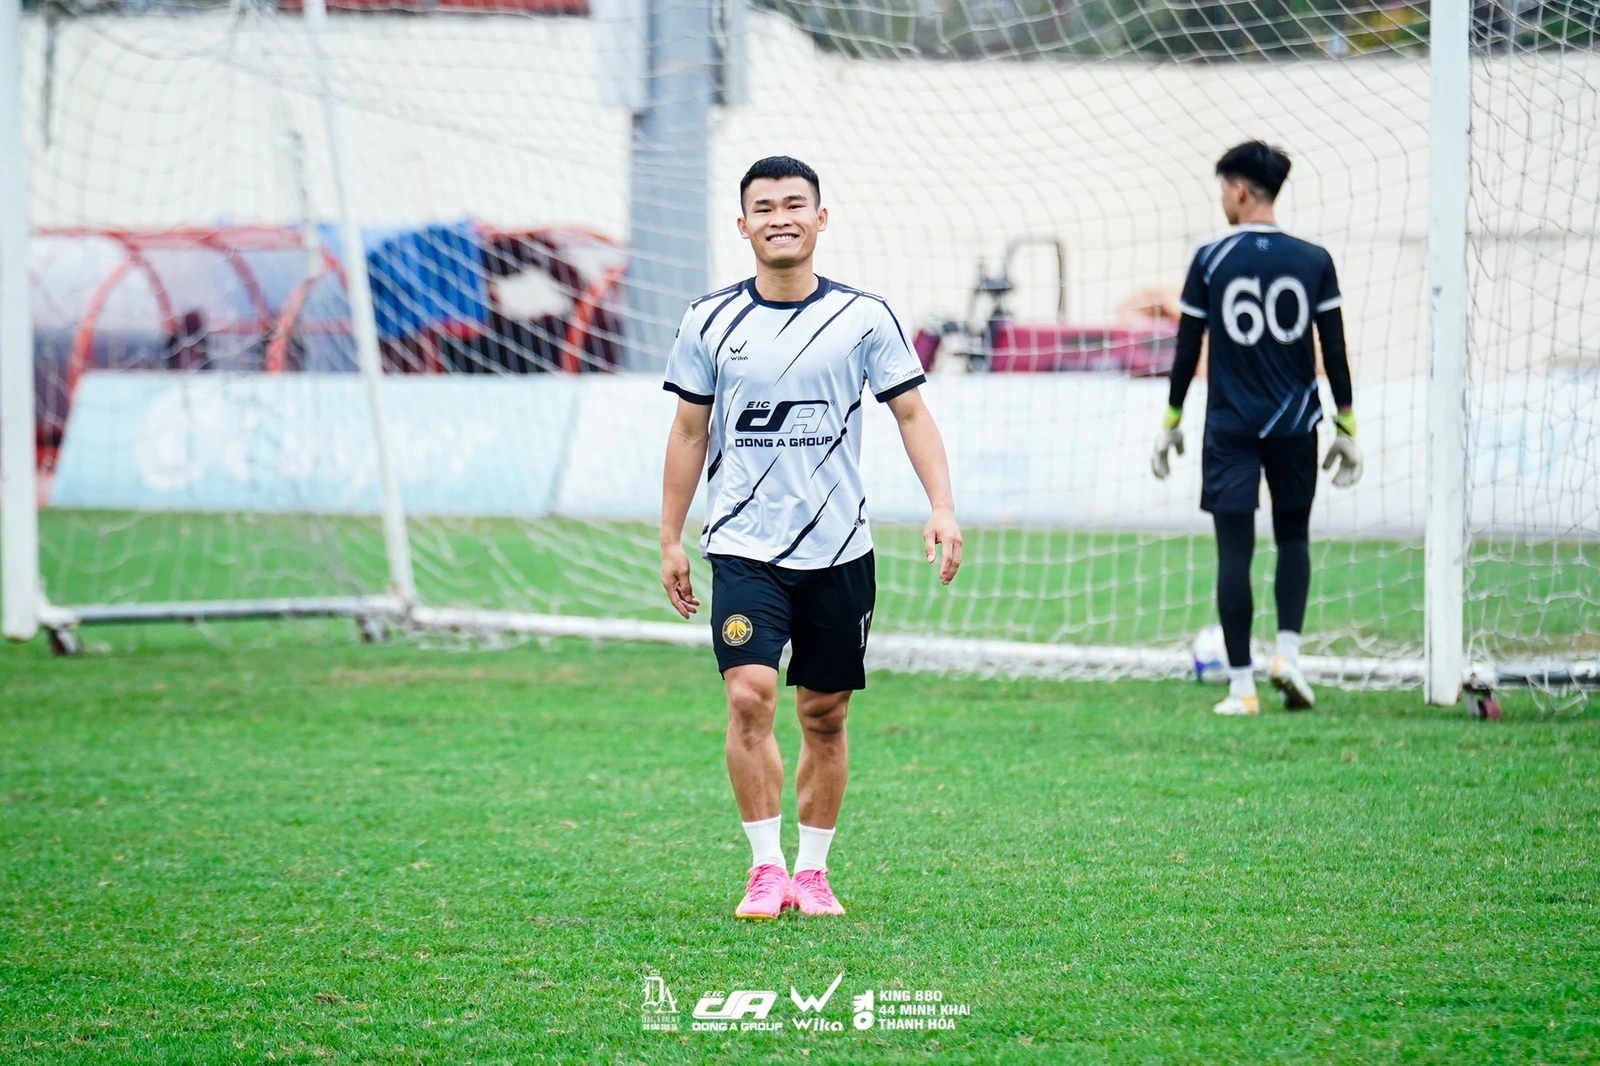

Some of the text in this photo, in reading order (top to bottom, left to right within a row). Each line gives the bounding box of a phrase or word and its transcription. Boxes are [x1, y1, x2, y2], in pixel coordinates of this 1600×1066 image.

[1222, 275, 1309, 346] 60
[746, 401, 771, 409] EIC
[735, 436, 833, 447] DONG A GROUP
